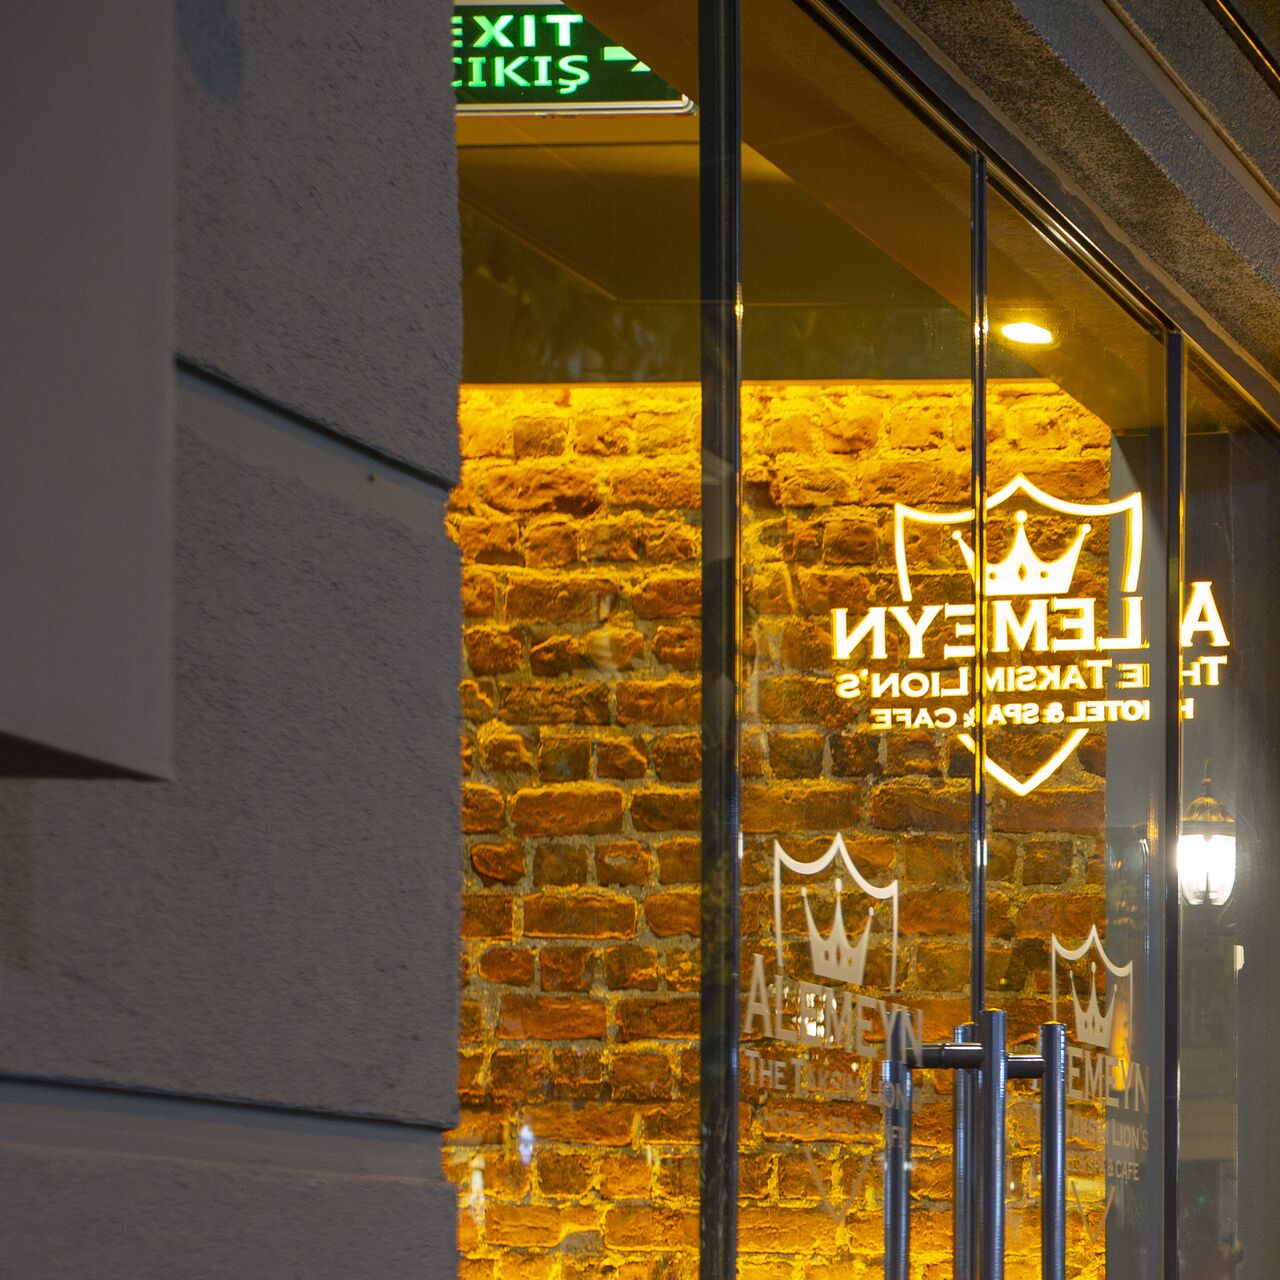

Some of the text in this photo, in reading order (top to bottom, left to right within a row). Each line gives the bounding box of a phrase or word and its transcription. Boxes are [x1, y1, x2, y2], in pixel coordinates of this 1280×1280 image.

[744, 952, 924, 1068] ALEMEYN
[745, 1049, 788, 1091] THE
[1050, 1045, 1150, 1114] EMEYN
